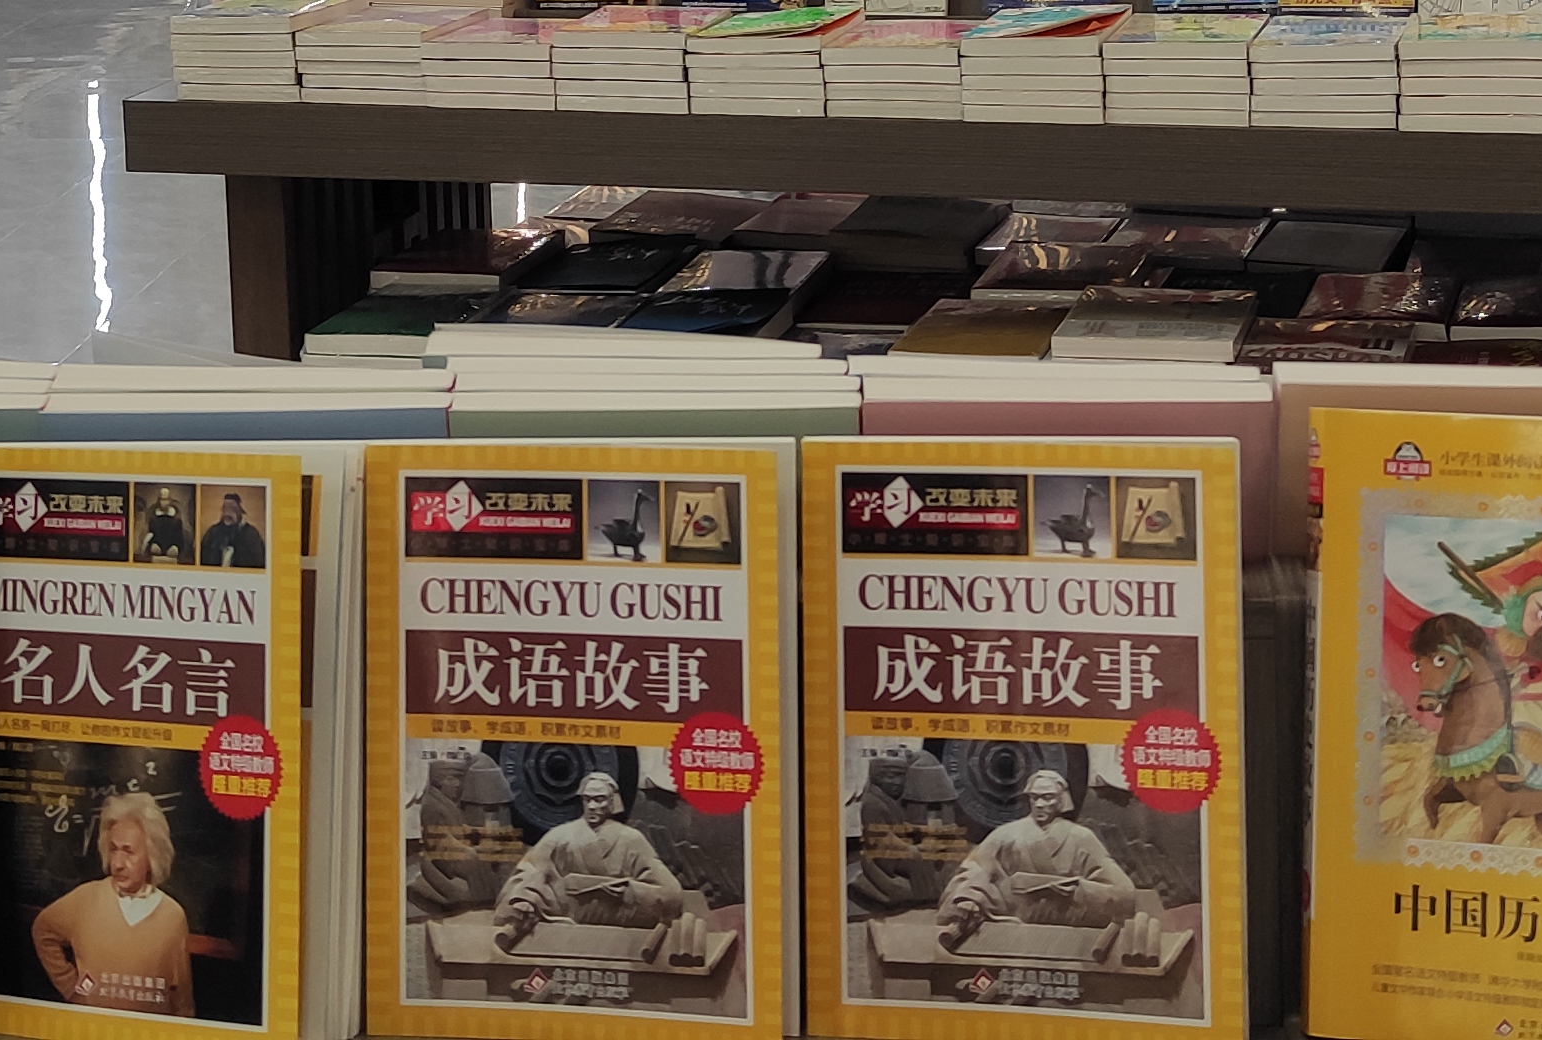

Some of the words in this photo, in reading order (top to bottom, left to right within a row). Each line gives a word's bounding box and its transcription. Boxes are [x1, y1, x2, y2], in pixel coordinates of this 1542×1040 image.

[49, 494, 124, 515] 改变未来
[412, 490, 477, 527] 学习
[485, 493, 573, 511] 改变未来
[850, 484, 916, 522] 学习
[925, 487, 1019, 507] 改变未来
[121, 585, 257, 627] MINGYAN
[420, 577, 601, 618] CHENGYU
[610, 581, 723, 622] GUSHI
[859, 573, 1048, 615] CHENGYU
[1058, 577, 1178, 619] GUSHI
[0, 637, 235, 717] 名人名言
[434, 637, 710, 713] 成语故事
[873, 633, 1164, 711] 成语故事
[1145, 724, 1199, 747] 全国名校
